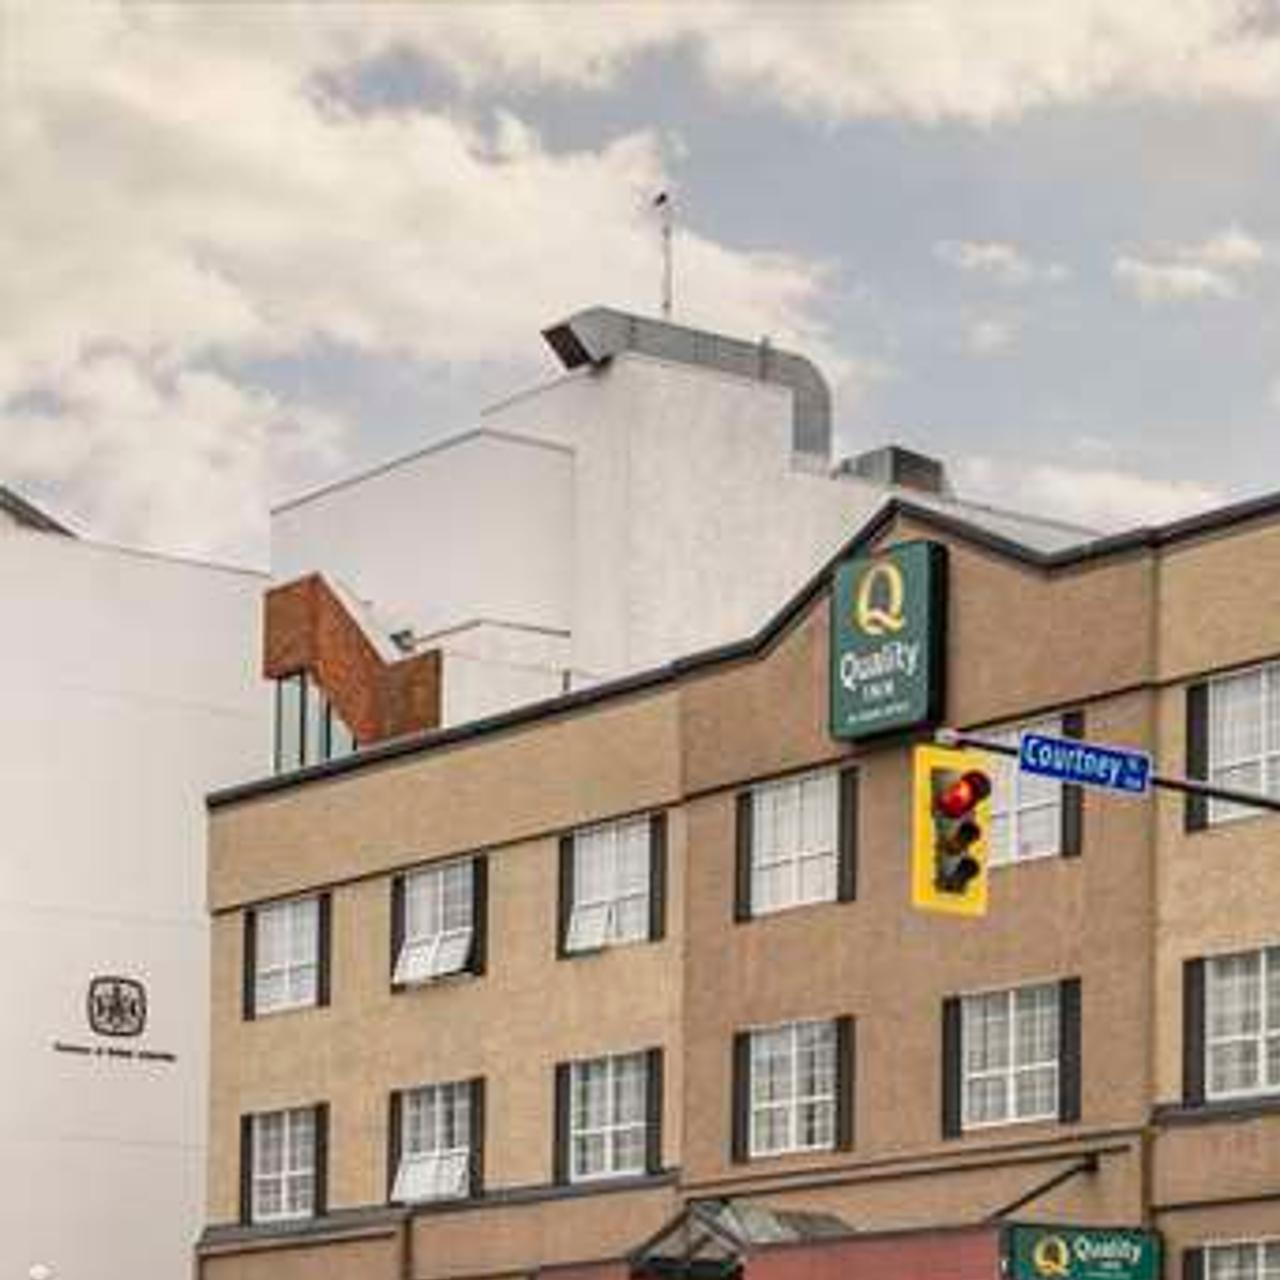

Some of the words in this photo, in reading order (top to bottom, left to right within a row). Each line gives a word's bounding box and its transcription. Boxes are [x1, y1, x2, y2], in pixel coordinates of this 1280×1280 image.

[857, 561, 906, 635] Q
[841, 641, 920, 692] Quality
[1027, 738, 1122, 784] Courtney
[1033, 1234, 1071, 1278] Q
[1073, 1234, 1142, 1266] Quality
